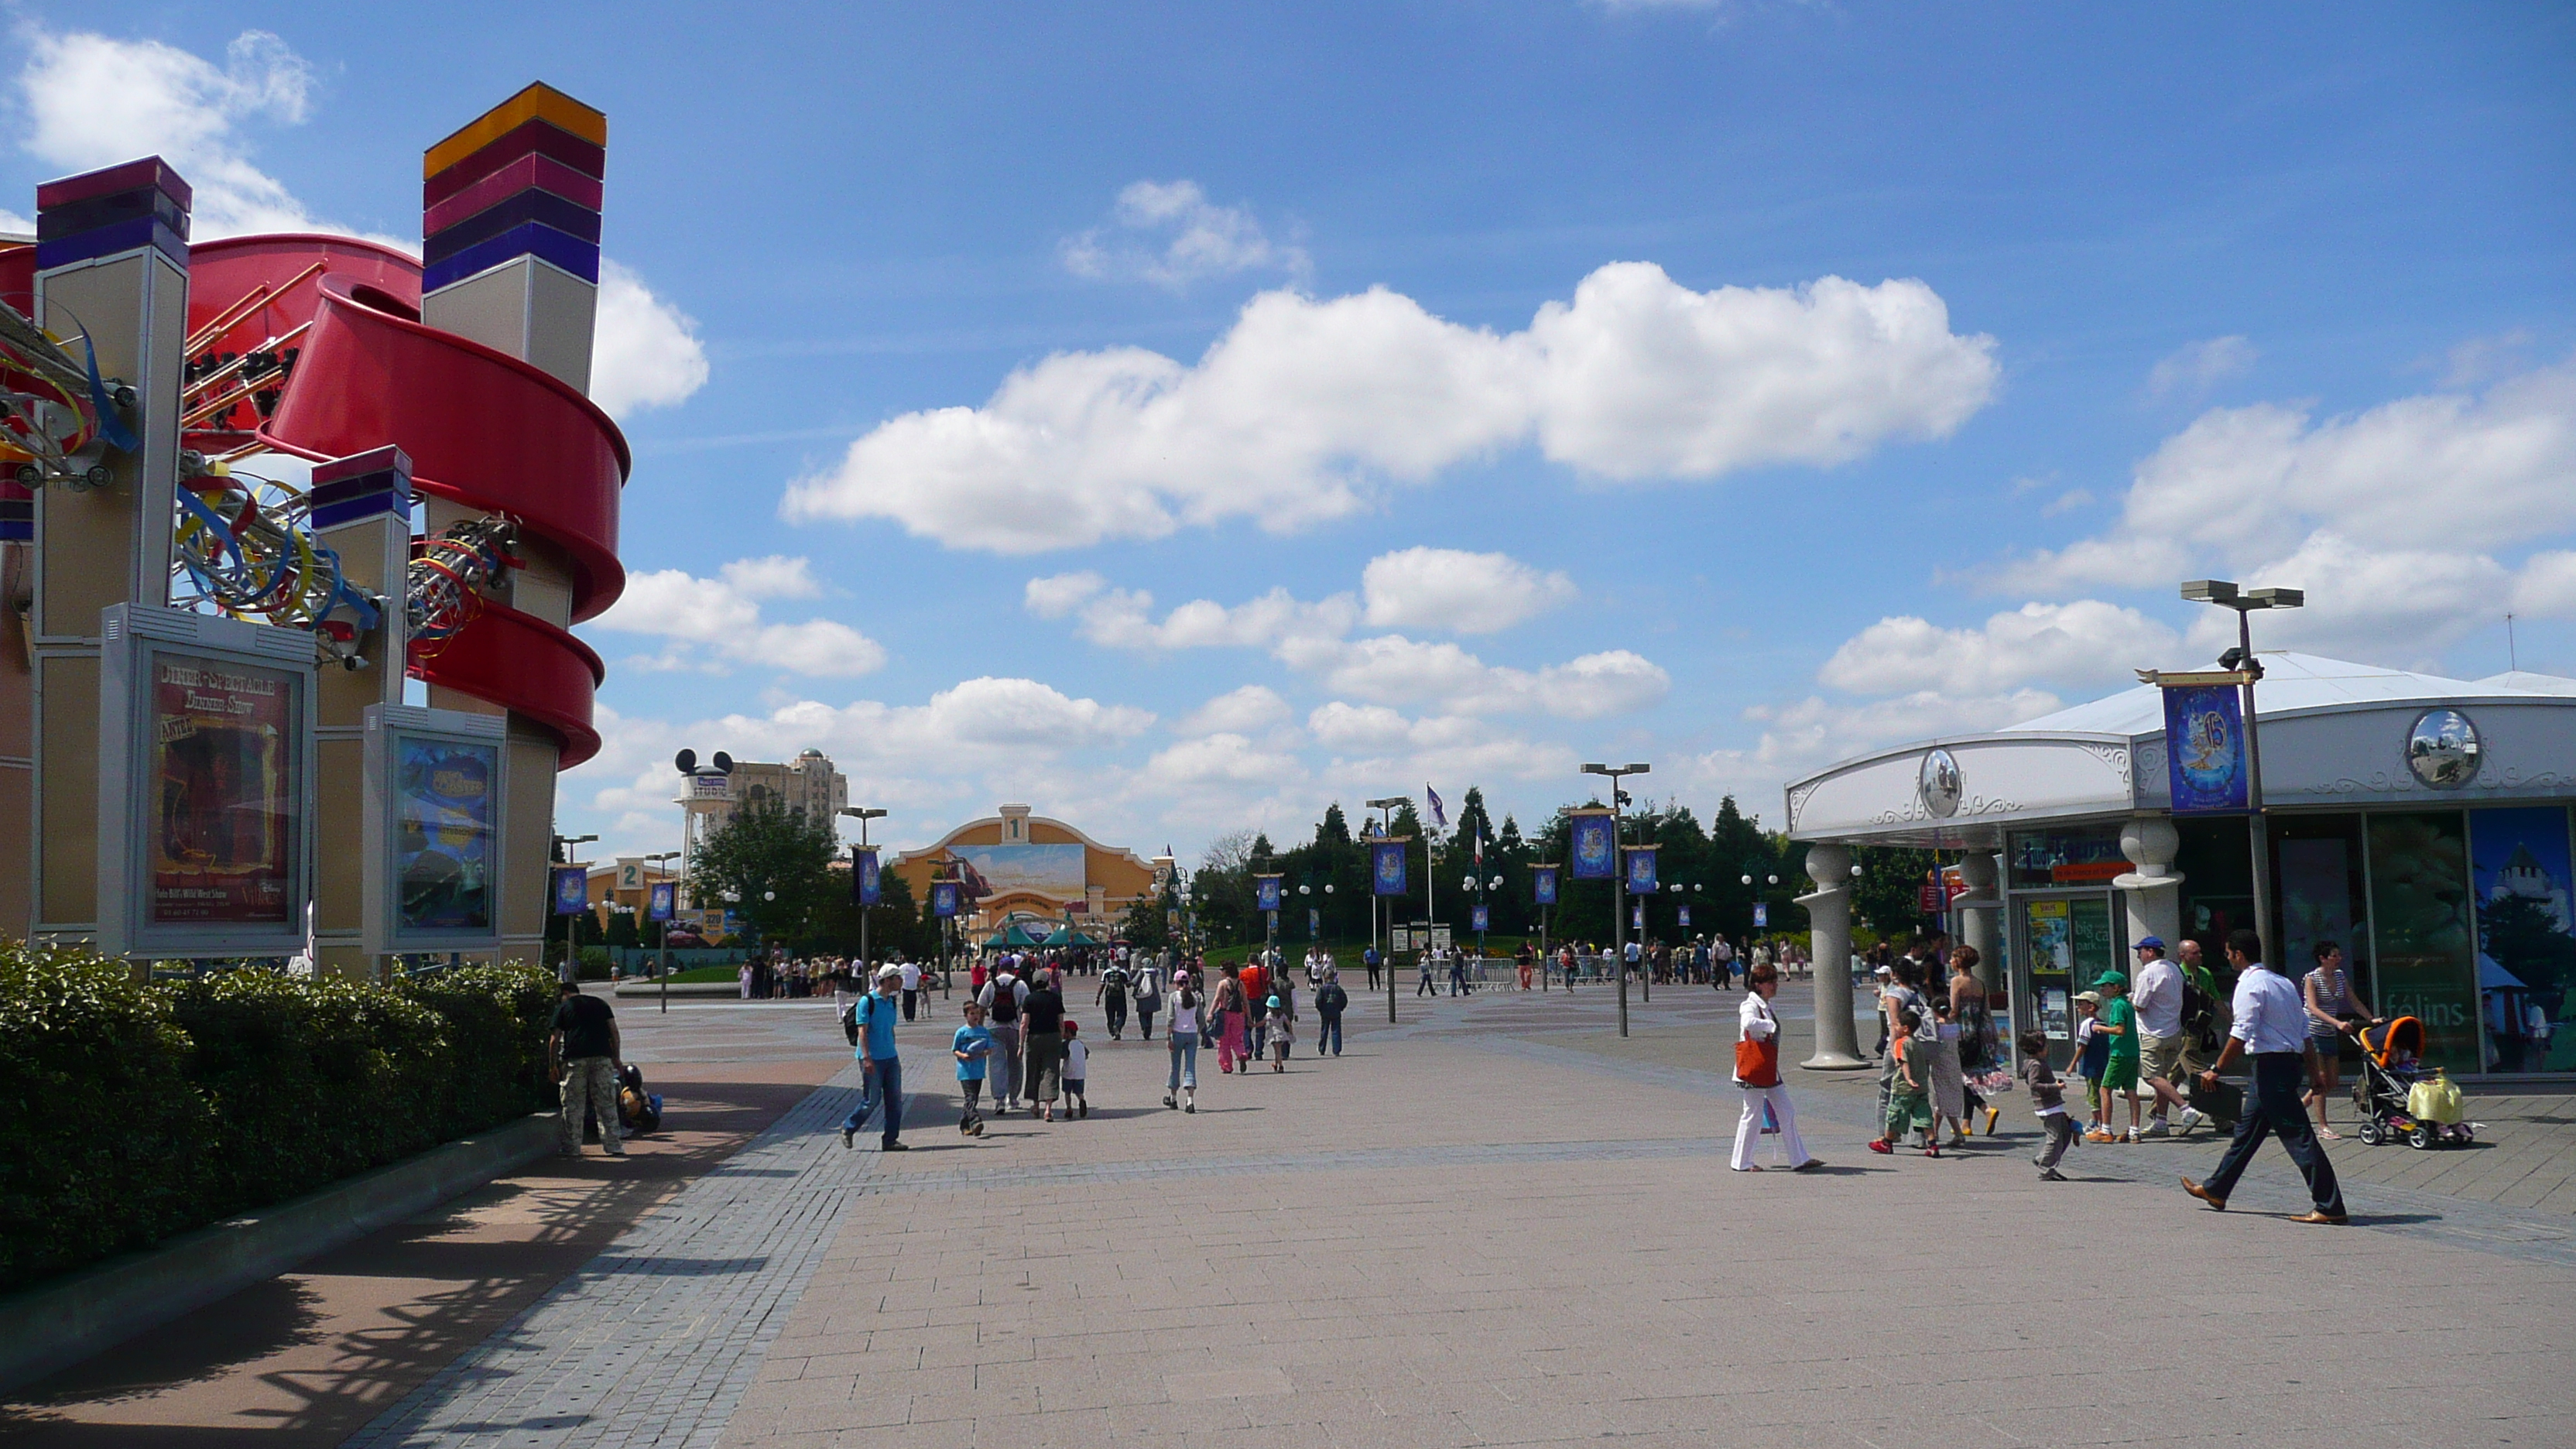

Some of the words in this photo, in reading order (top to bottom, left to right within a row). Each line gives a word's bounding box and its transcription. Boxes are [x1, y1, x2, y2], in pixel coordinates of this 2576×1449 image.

[1010, 819, 1018, 838] 1
[625, 865, 636, 885] 2
[705, 914, 721, 924] 320
[2074, 920, 2094, 939] big
[2076, 940, 2098, 953] park
